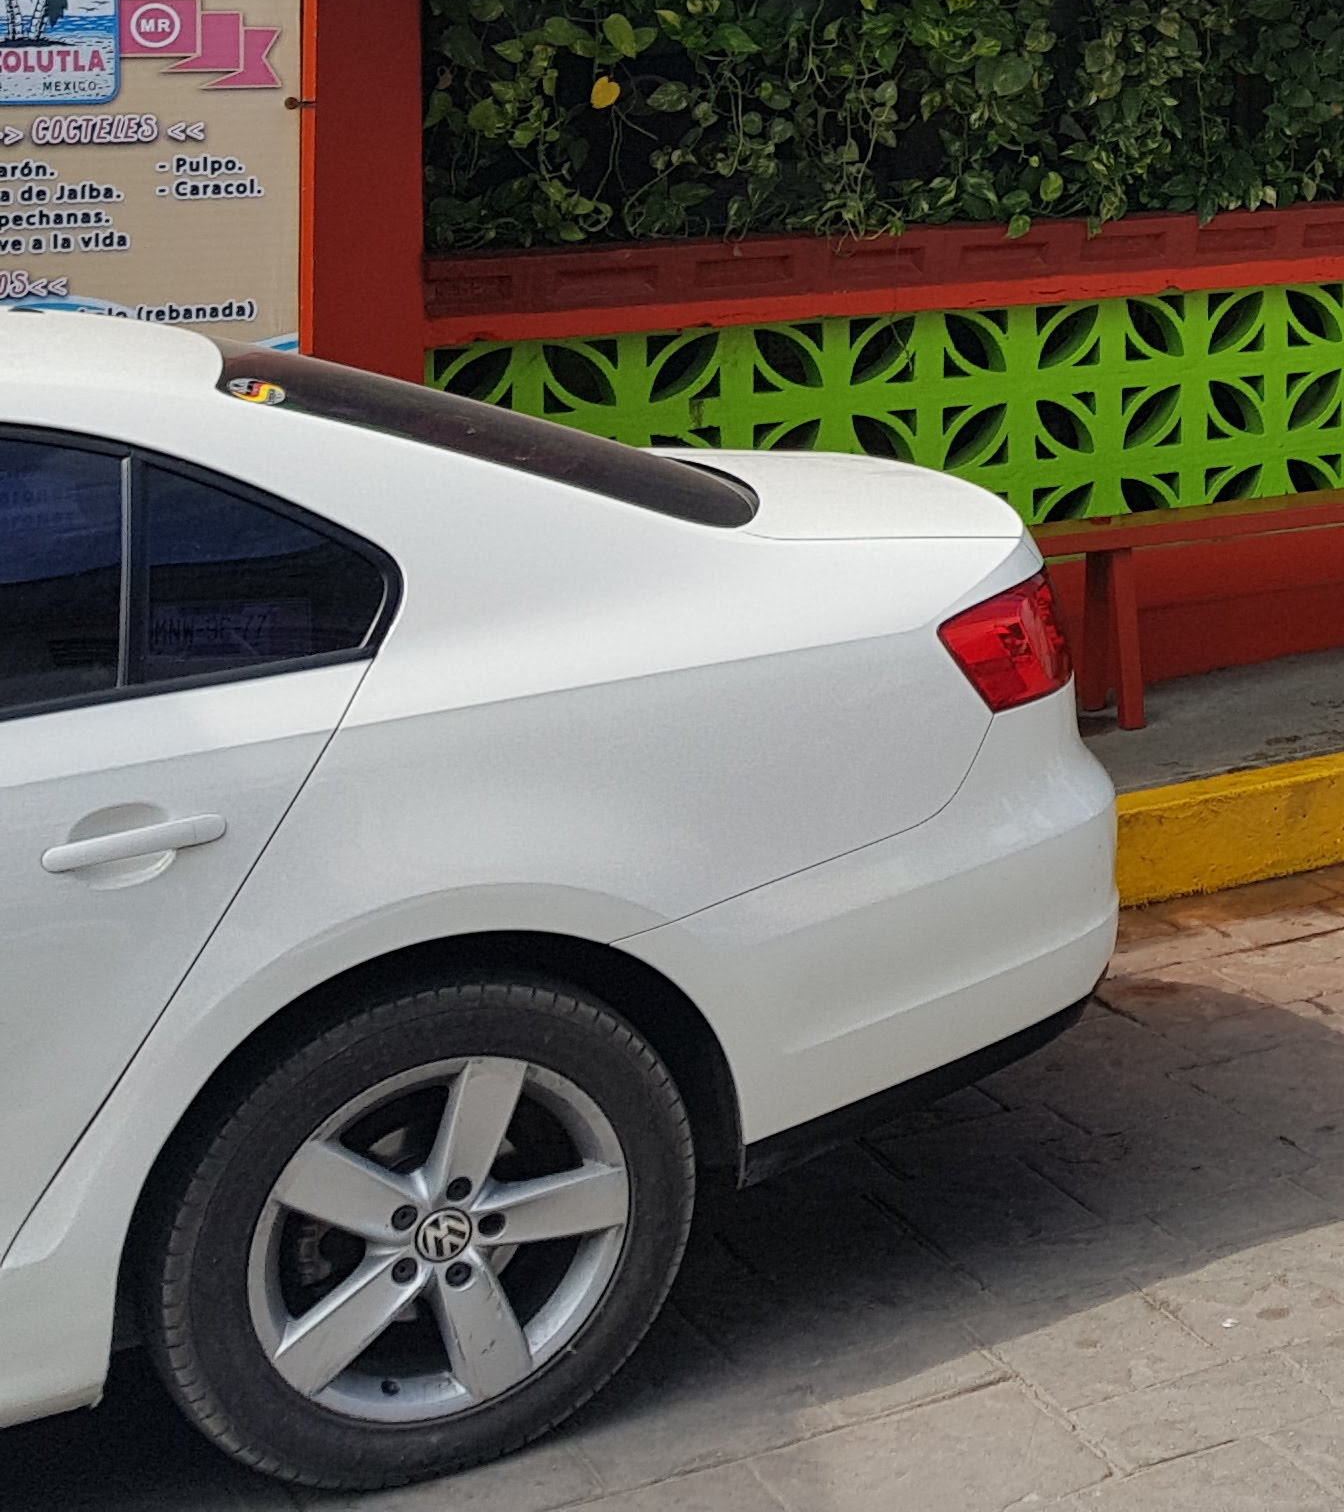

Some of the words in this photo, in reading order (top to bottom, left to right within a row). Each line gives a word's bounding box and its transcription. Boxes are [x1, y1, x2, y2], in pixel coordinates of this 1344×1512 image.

[141, 18, 171, 32] MR
[0, 51, 106, 73] OLUTLA
[43, 81, 96, 91] MEXICO
[33, 116, 156, 141] COCTELES
[0, 161, 55, 177] arón.
[175, 156, 242, 174] Pulpo.
[21, 186, 46, 201] de
[175, 180, 263, 196] Caracol.
[0, 210, 110, 229] pechanas.
[32, 239, 42, 249] a
[53, 234, 71, 249] la
[81, 232, 127, 248] vida
[138, 300, 254, 320] (rebanada)
